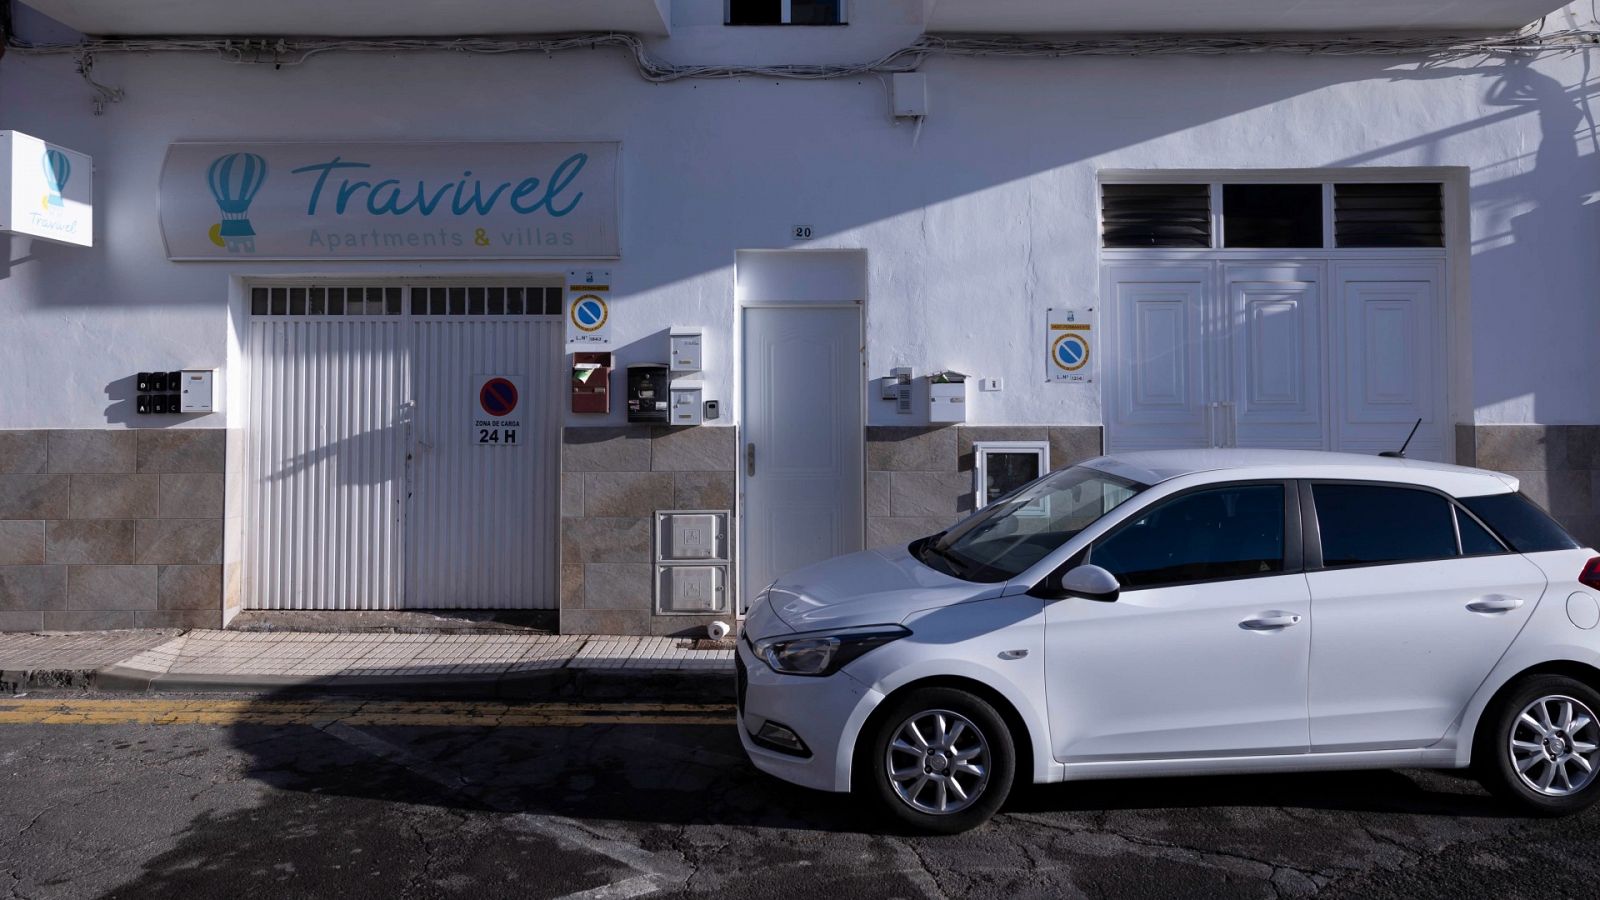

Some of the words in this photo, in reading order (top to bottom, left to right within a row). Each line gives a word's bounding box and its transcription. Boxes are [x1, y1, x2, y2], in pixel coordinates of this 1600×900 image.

[291, 152, 588, 217] Travivel
[308, 227, 464, 251] Apartments
[474, 227, 490, 246] &
[501, 226, 575, 246] villas
[796, 227, 811, 238] 20
[479, 429, 499, 443] 24
[504, 429, 516, 443] H
